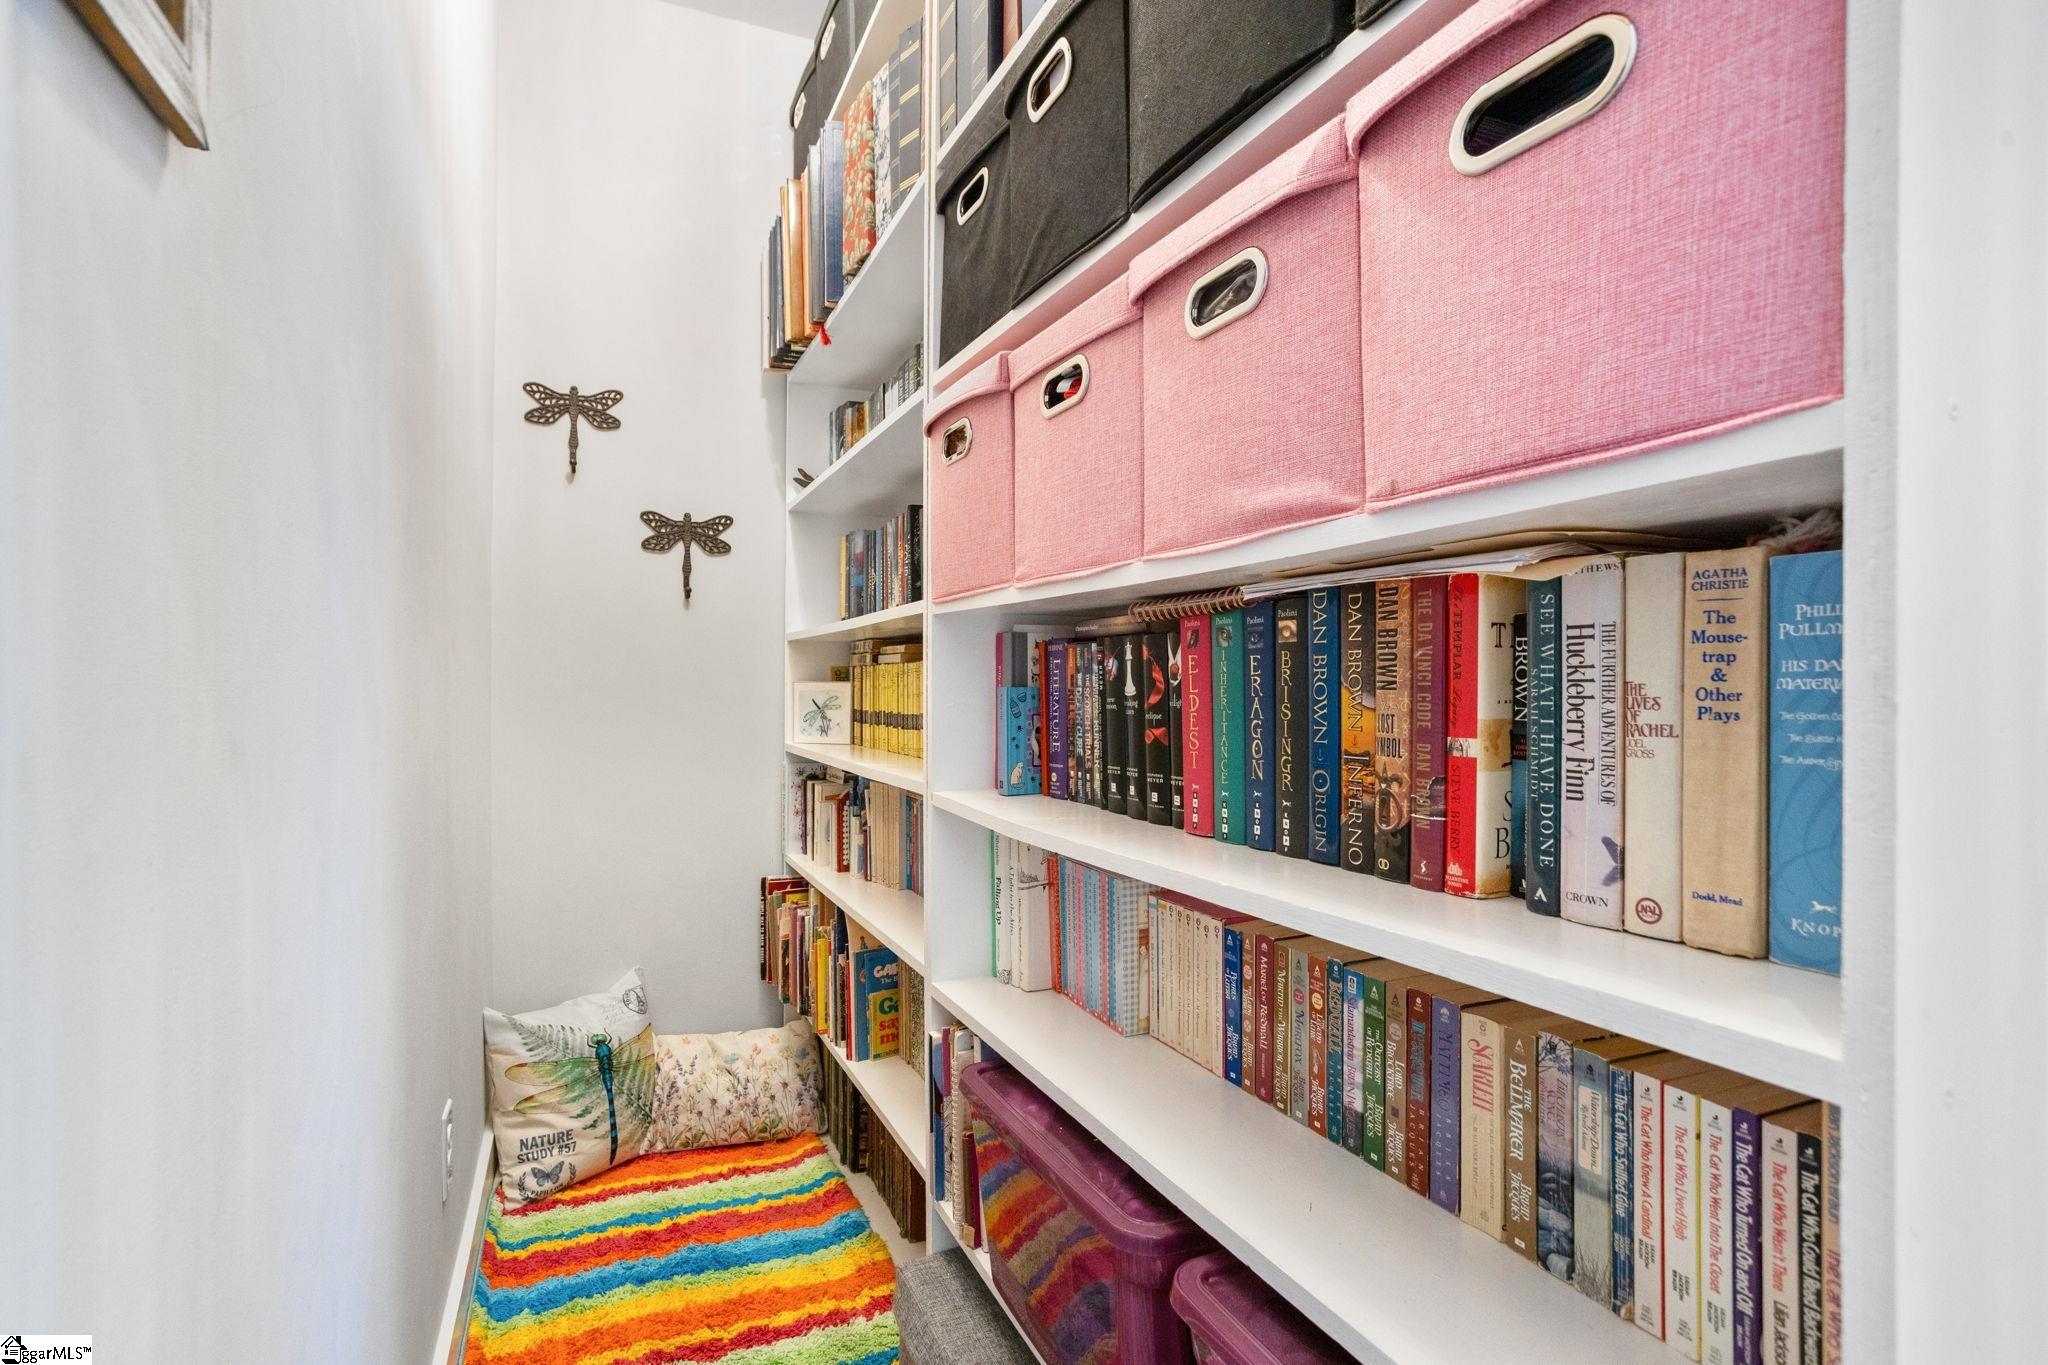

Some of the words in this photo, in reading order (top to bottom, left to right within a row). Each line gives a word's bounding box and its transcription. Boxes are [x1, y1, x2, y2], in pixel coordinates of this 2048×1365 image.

[1691, 578, 1749, 592] CHRISTIE
[1693, 567, 1748, 581] AGATHA
[1277, 608, 1298, 618] Paolini
[1348, 591, 1363, 642] DAN
[1377, 585, 1399, 623] DAN
[1419, 589, 1432, 615] THE
[1540, 593, 1555, 636] SEE
[1246, 616, 1264, 625] Paolini
[1312, 590, 1328, 645] DAN
[1417, 622, 1432, 641] DA
[1703, 610, 1737, 625] The
[1452, 608, 1463, 681] TEMPLAR
[1600, 620, 1616, 647] THE
[1691, 630, 1749, 645] Mouse-
[1376, 627, 1399, 691] BROWN
[1417, 645, 1432, 687] VINCI
[1702, 650, 1737, 666] trap
[1782, 660, 1808, 672] HIS
[1514, 636, 1528, 722] BROWN
[1540, 642, 1555, 711] WHAT
[1562, 622, 1595, 752] Huckleberry
[1600, 648, 1616, 704] FURTHER
[1710, 668, 1728, 683] &
[1051, 658, 1061, 753] LITERATURE
[1312, 654, 1328, 745] BROWN
[1347, 649, 1363, 733] BROWN
[1530, 667, 1538, 720] SARAH
[1625, 697, 1661, 711] LIVES
[1695, 686, 1743, 702] Other
[1083, 688, 1092, 730] SCORCH
[1187, 654, 1200, 769] ELDEST
[1220, 649, 1231, 785] INHERITANCE
[1249, 654, 1264, 781] ERAGON
[1280, 650, 1294, 792] BRISINGR
[1377, 713, 1395, 734] LOST
[1417, 692, 1431, 730] CODE
[1625, 723, 1680, 738] RACHEL
[1084, 732, 1092, 769] TRIALS
[1417, 743, 1431, 772] DAN
[1600, 704, 1616, 788] ADVENTURES
[1530, 724, 1539, 802] SCHMIDT
[1540, 733, 1555, 794] HAVE
[1451, 765, 1460, 803] STEVE
[1565, 755, 1596, 802] Finn
[1312, 768, 1330, 853] ORIGIN
[1344, 752, 1369, 866] INFERNO
[1416, 778, 1431, 830] BROWN
[1600, 790, 1616, 807] OF
[1451, 809, 1460, 852] BERRY
[1540, 802, 1555, 868] DONE
[1565, 891, 1609, 908] CROWN
[1719, 894, 1743, 907] Mead
[1260, 955, 1268, 991] MARIEL
[1260, 1004, 1268, 1049] REDWALL
[1366, 1035, 1375, 1080] REDWALL
[1374, 1041, 1384, 1085] OUTCAST
[1387, 1040, 1397, 1100] BROCKTREE
[1395, 1060, 1405, 1090] LORD
[1468, 1039, 1495, 1115] SCARLETT
[1366, 1092, 1376, 1138] JACQUES
[1509, 1058, 1527, 1161] BELLMAKER
[1524, 1089, 1533, 1113] THE
[1615, 1094, 1627, 1112] The
[1641, 1104, 1653, 1122] The
[1375, 1103, 1385, 1136] BRIAN
[1615, 1113, 1627, 1131] Cat
[1641, 1122, 1653, 1139] Cat
[1676, 1125, 1687, 1142] The
[516, 1145, 555, 1164] STUDY
[557, 1140, 577, 1156] #57
[519, 1128, 574, 1152] NATURE
[1387, 1121, 1397, 1164] JACQUES
[1395, 1131, 1405, 1163] BRIAN
[1615, 1131, 1627, 1154] Who
[1641, 1140, 1652, 1161] Who
[1676, 1142, 1687, 1160] Cat
[1709, 1134, 1722, 1152] The
[1736, 1141, 1753, 1164] The
[1641, 1162, 1653, 1188] Knew
[1676, 1163, 1687, 1186] Who
[1709, 1153, 1722, 1172] Cat
[1736, 1163, 1753, 1185] Cat
[1772, 1161, 1787, 1181] The
[1508, 1169, 1521, 1223] JACQUES
[1642, 1189, 1652, 1197] A
[1709, 1173, 1722, 1195] Who
[1772, 1182, 1787, 1201] Cat
[1801, 1170, 1820, 1193] The
[1520, 1182, 1533, 1221] BRIAN
[1615, 1194, 1627, 1217] Glue
[1676, 1187, 1688, 1217] Lived
[1709, 1196, 1722, 1221] Went
[1736, 1184, 1753, 1213] Who
[1772, 1201, 1787, 1226] Who
[1801, 1192, 1820, 1214] Cat
[1641, 1199, 1653, 1240] Cardinal
[1672, 1217, 1687, 1241] High
[1710, 1221, 1723, 1243] Into
[1736, 1212, 1753, 1256] Turned
[1801, 1213, 1820, 1243] Who
[1710, 1243, 1723, 1260] The
[1772, 1226, 1787, 1262] Wasn't
[1736, 1251, 1753, 1271] On
[1802, 1242, 1820, 1279] Could
[1710, 1262, 1723, 1295] Closet
[1736, 1270, 1752, 1298] and
[1772, 1263, 1788, 1293] There
[1802, 1276, 1821, 1309] Read
